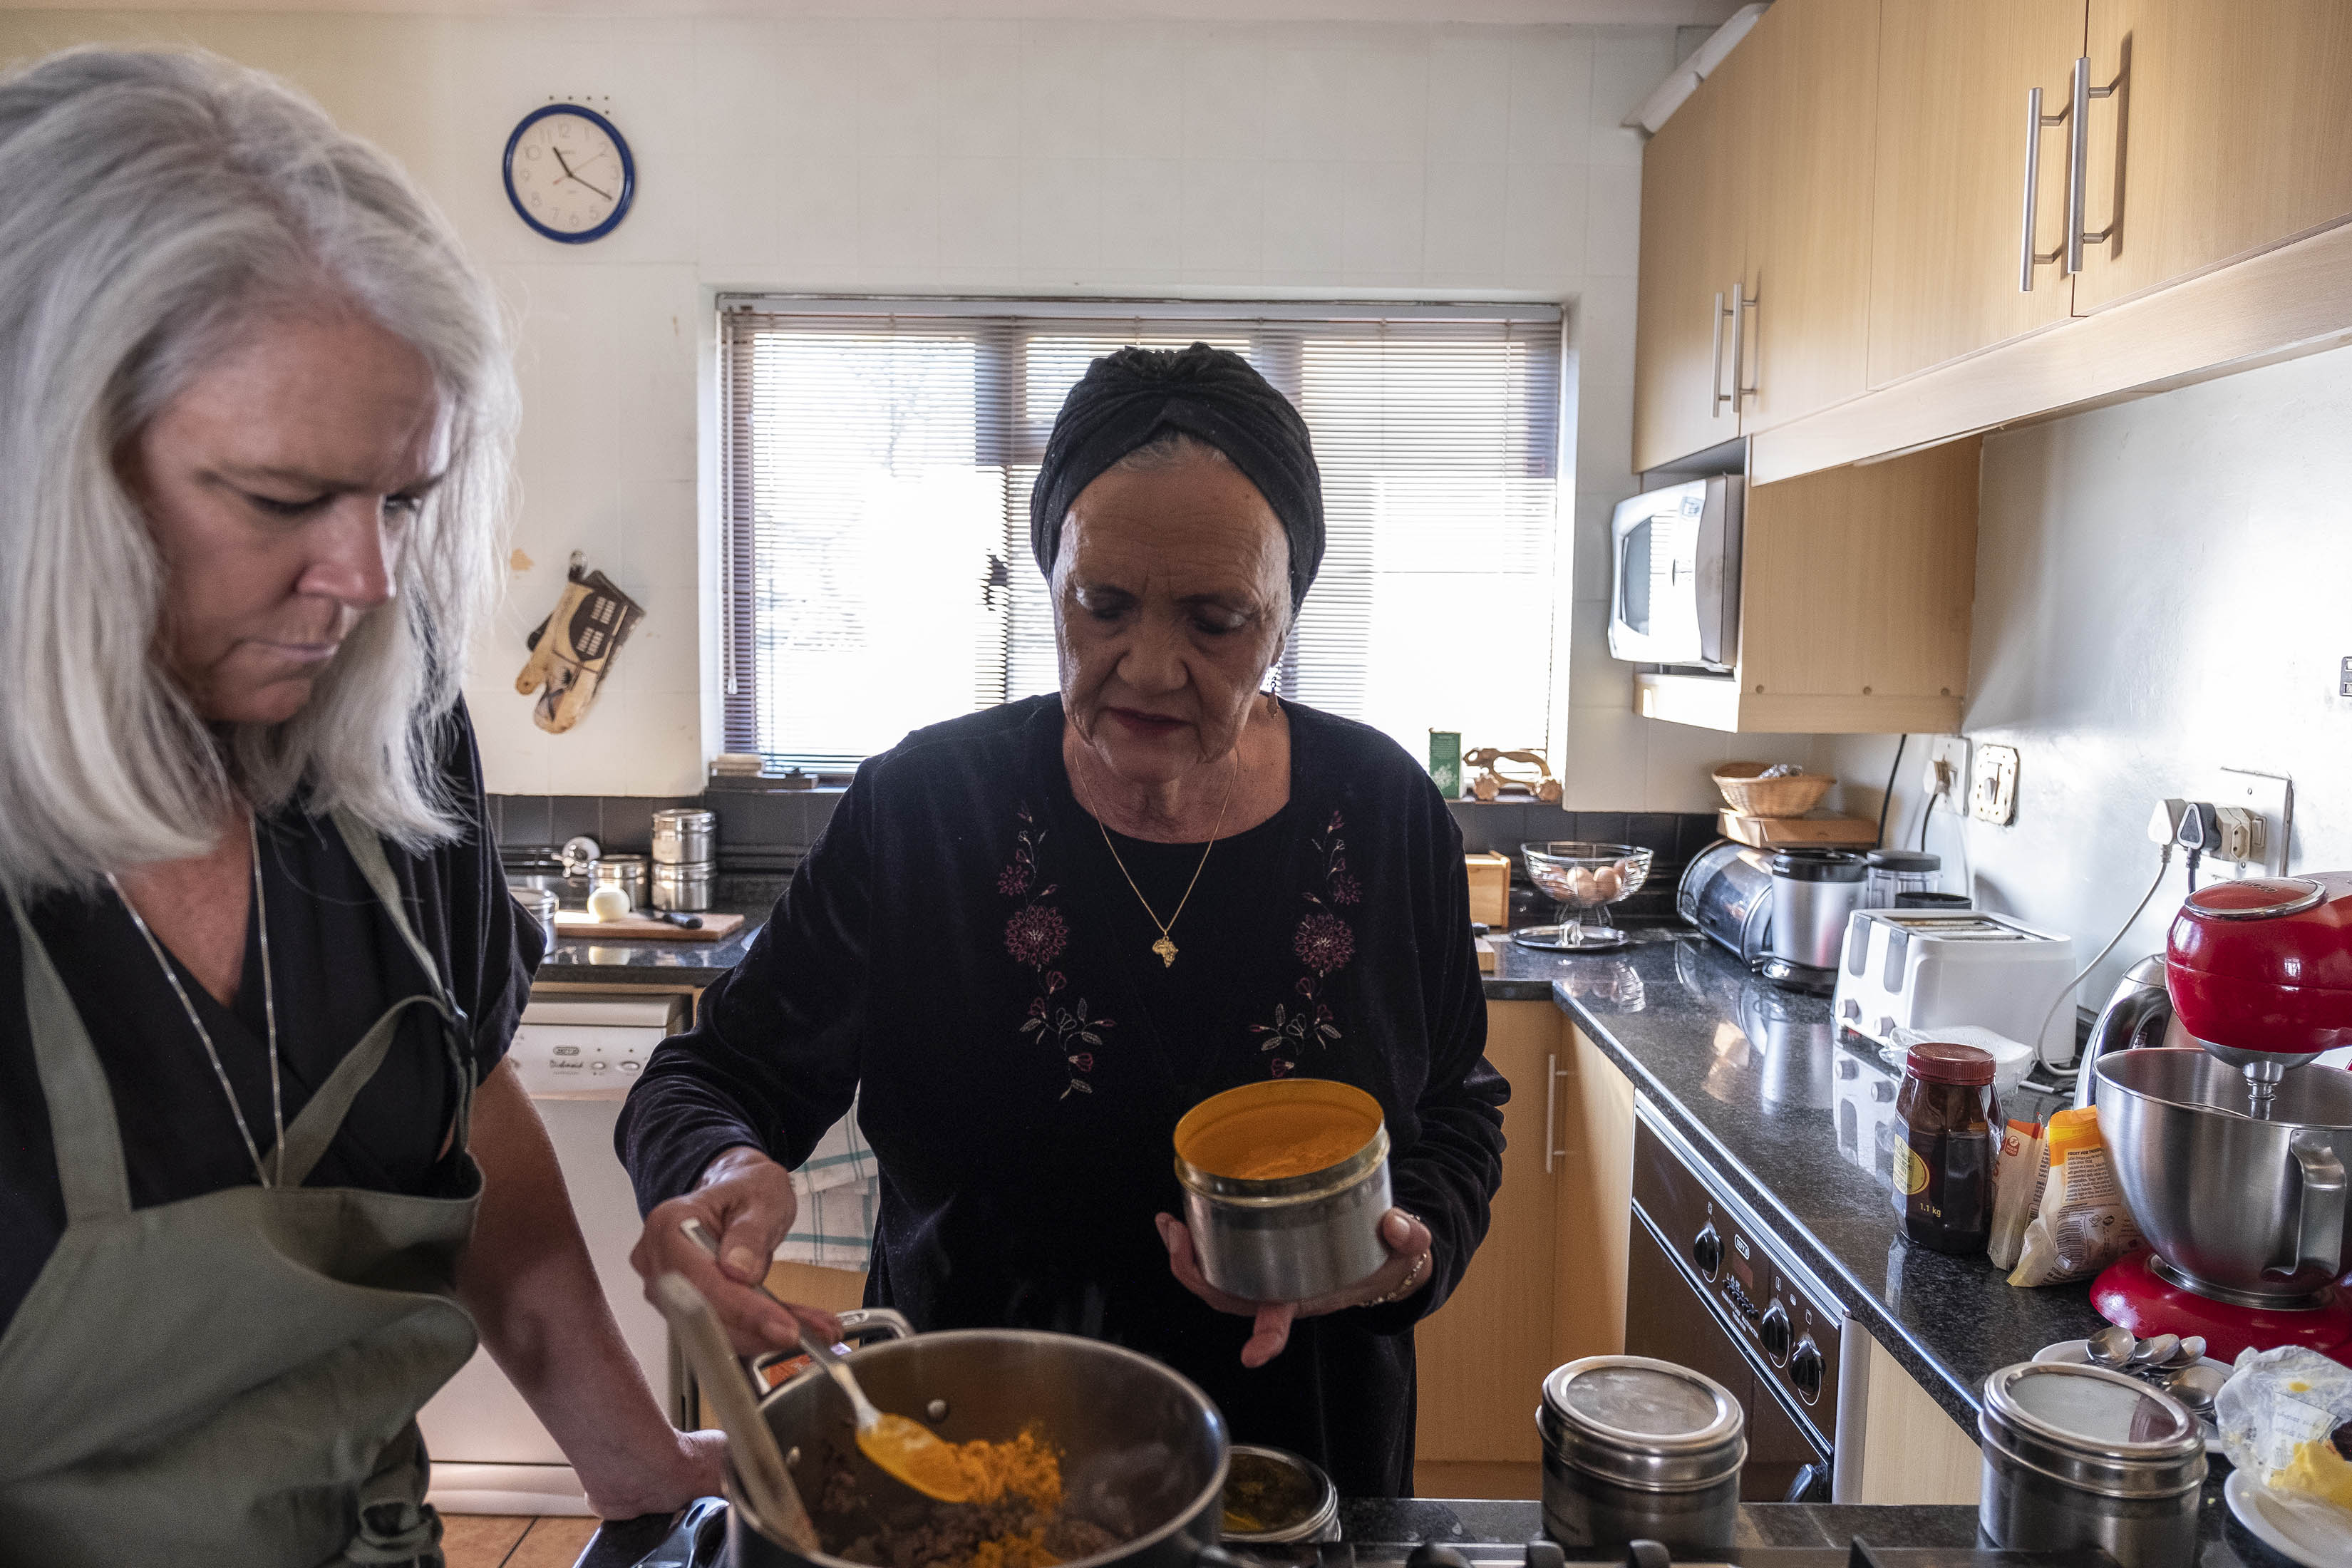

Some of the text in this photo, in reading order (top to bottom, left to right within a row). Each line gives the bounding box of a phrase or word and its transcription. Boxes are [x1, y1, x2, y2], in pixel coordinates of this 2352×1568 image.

[557, 123, 571, 138] 12
[1920, 1203, 1941, 1217] 1.1 kg
